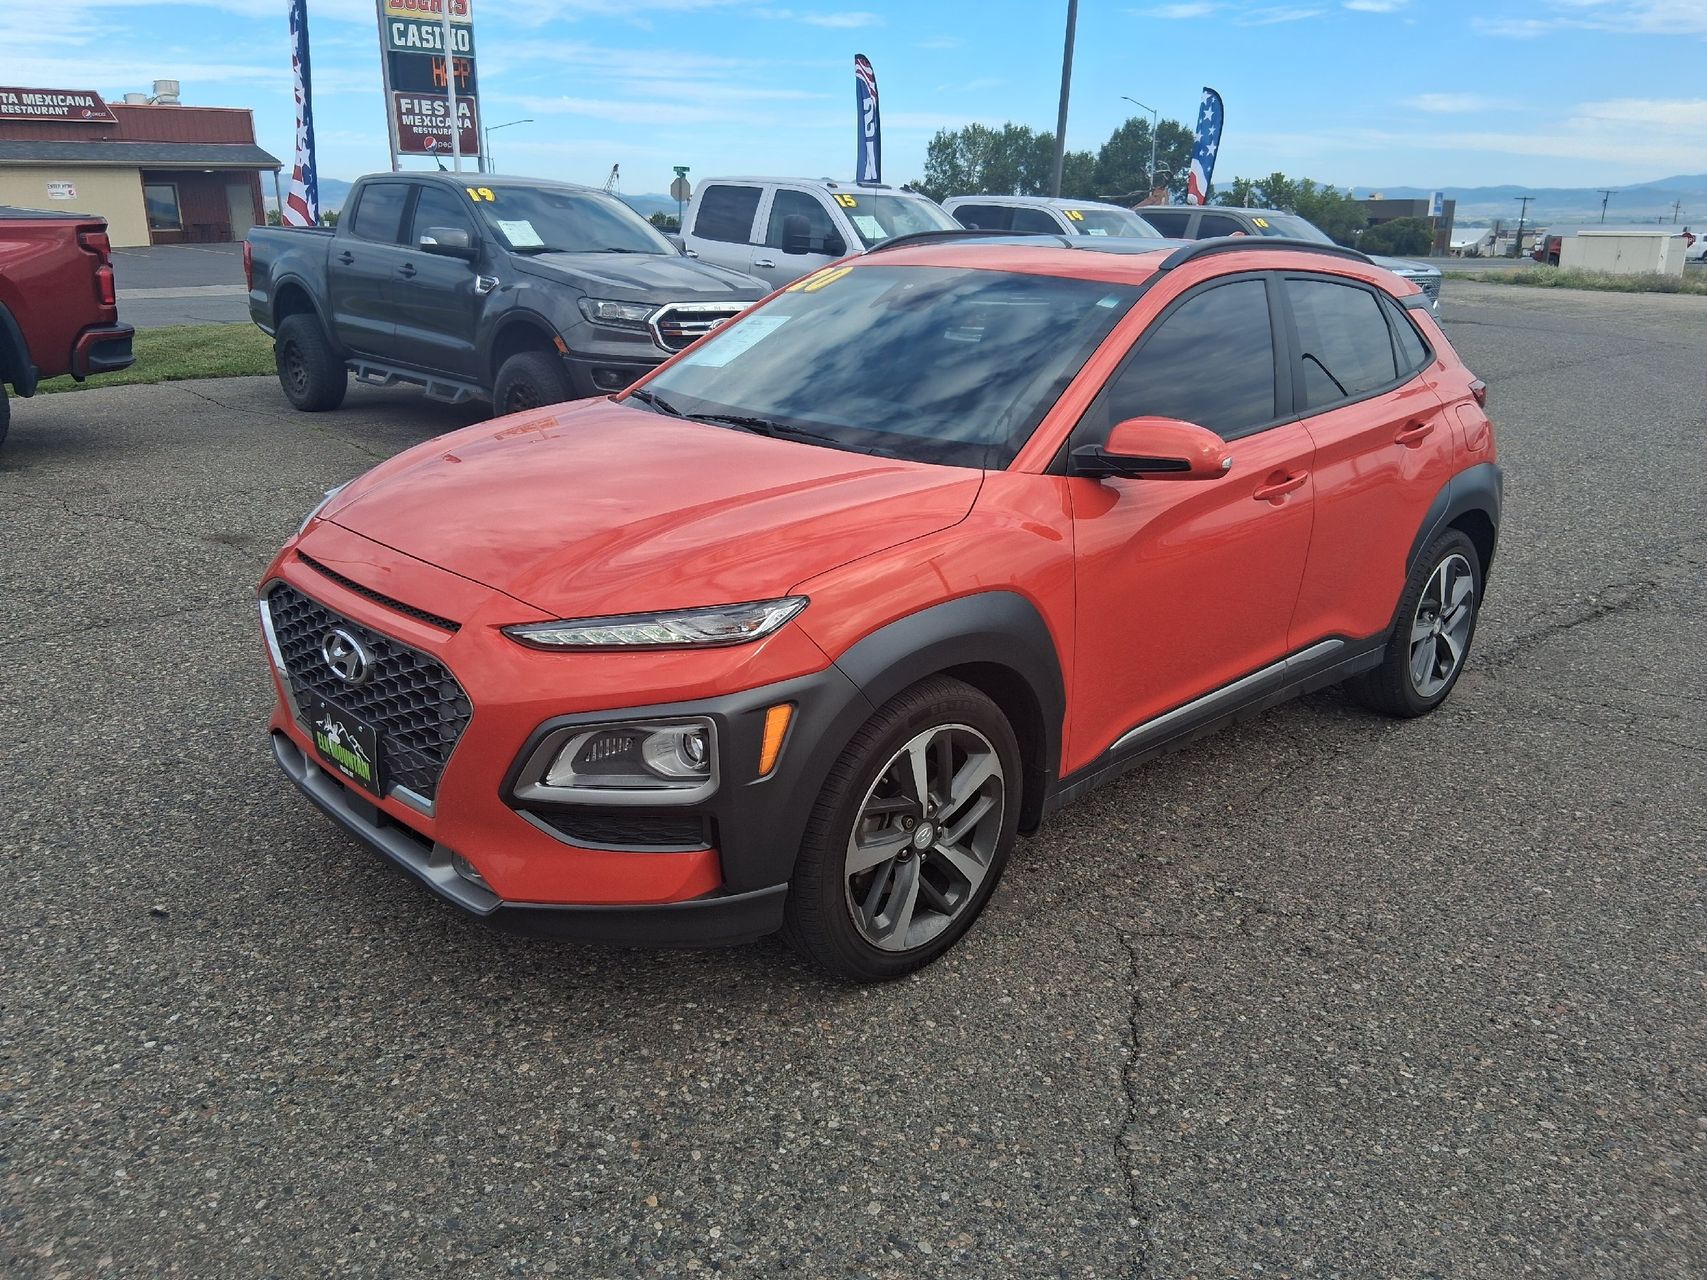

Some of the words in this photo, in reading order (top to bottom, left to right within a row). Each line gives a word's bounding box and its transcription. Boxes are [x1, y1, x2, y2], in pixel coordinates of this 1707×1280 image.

[392, 22, 470, 52] CASINO
[22, 93, 95, 107] MEXICANA
[1, 104, 69, 115] RESTAURANT
[437, 141, 454, 149] pep
[466, 187, 495, 202] 19
[833, 194, 857, 208] 15
